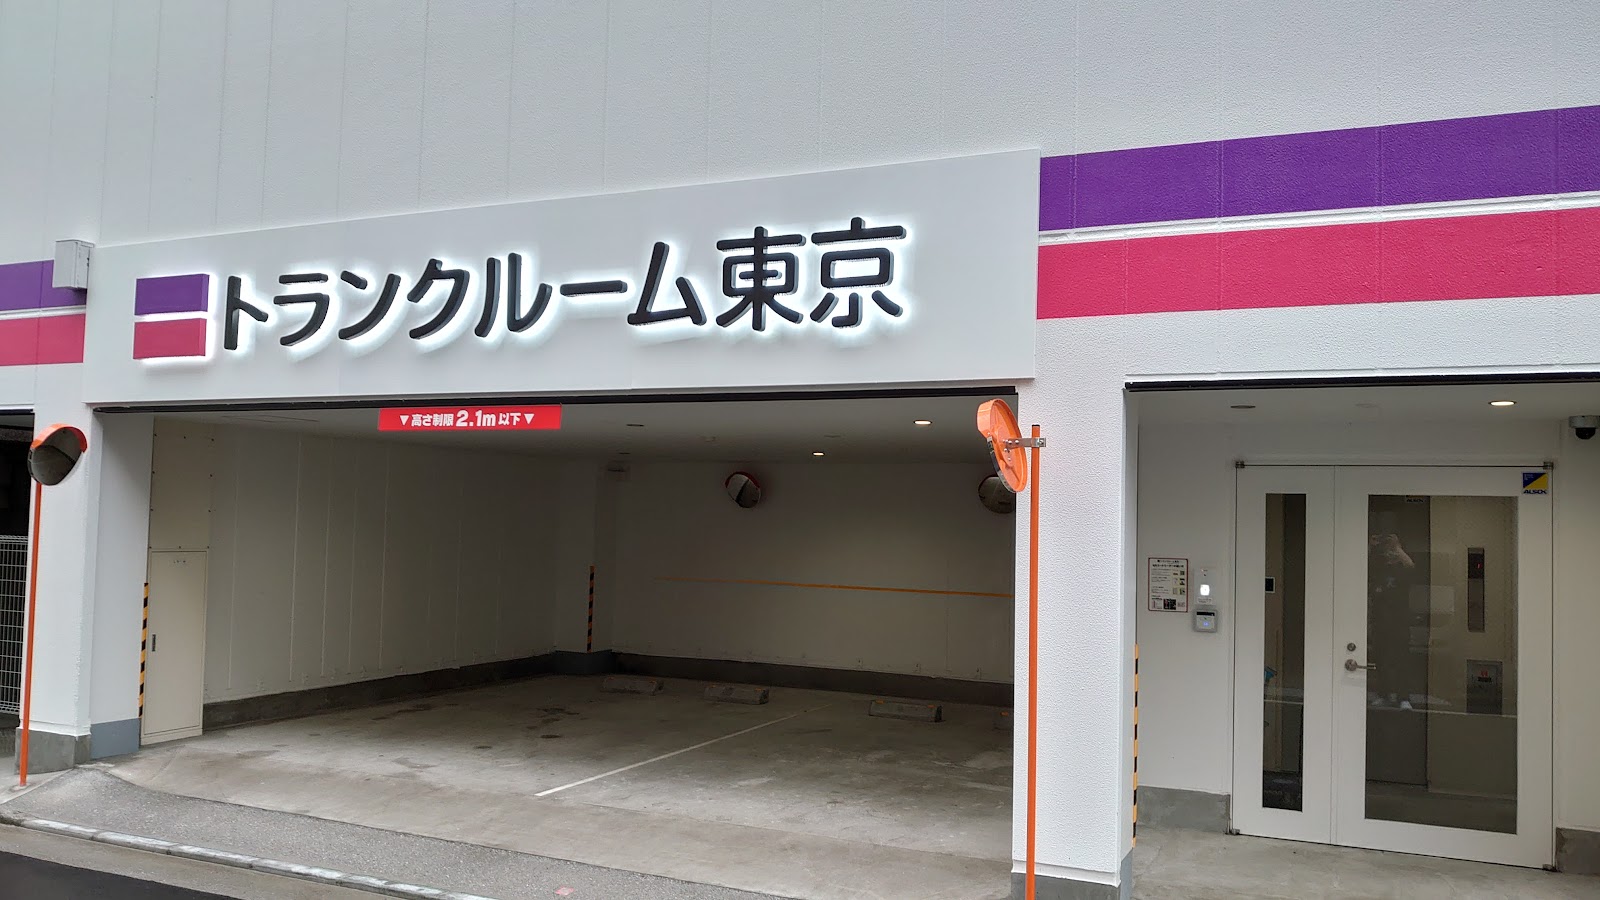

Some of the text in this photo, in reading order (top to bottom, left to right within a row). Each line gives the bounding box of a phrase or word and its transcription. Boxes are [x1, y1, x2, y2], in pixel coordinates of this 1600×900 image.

[223, 217, 907, 350] トランクルーム東京
